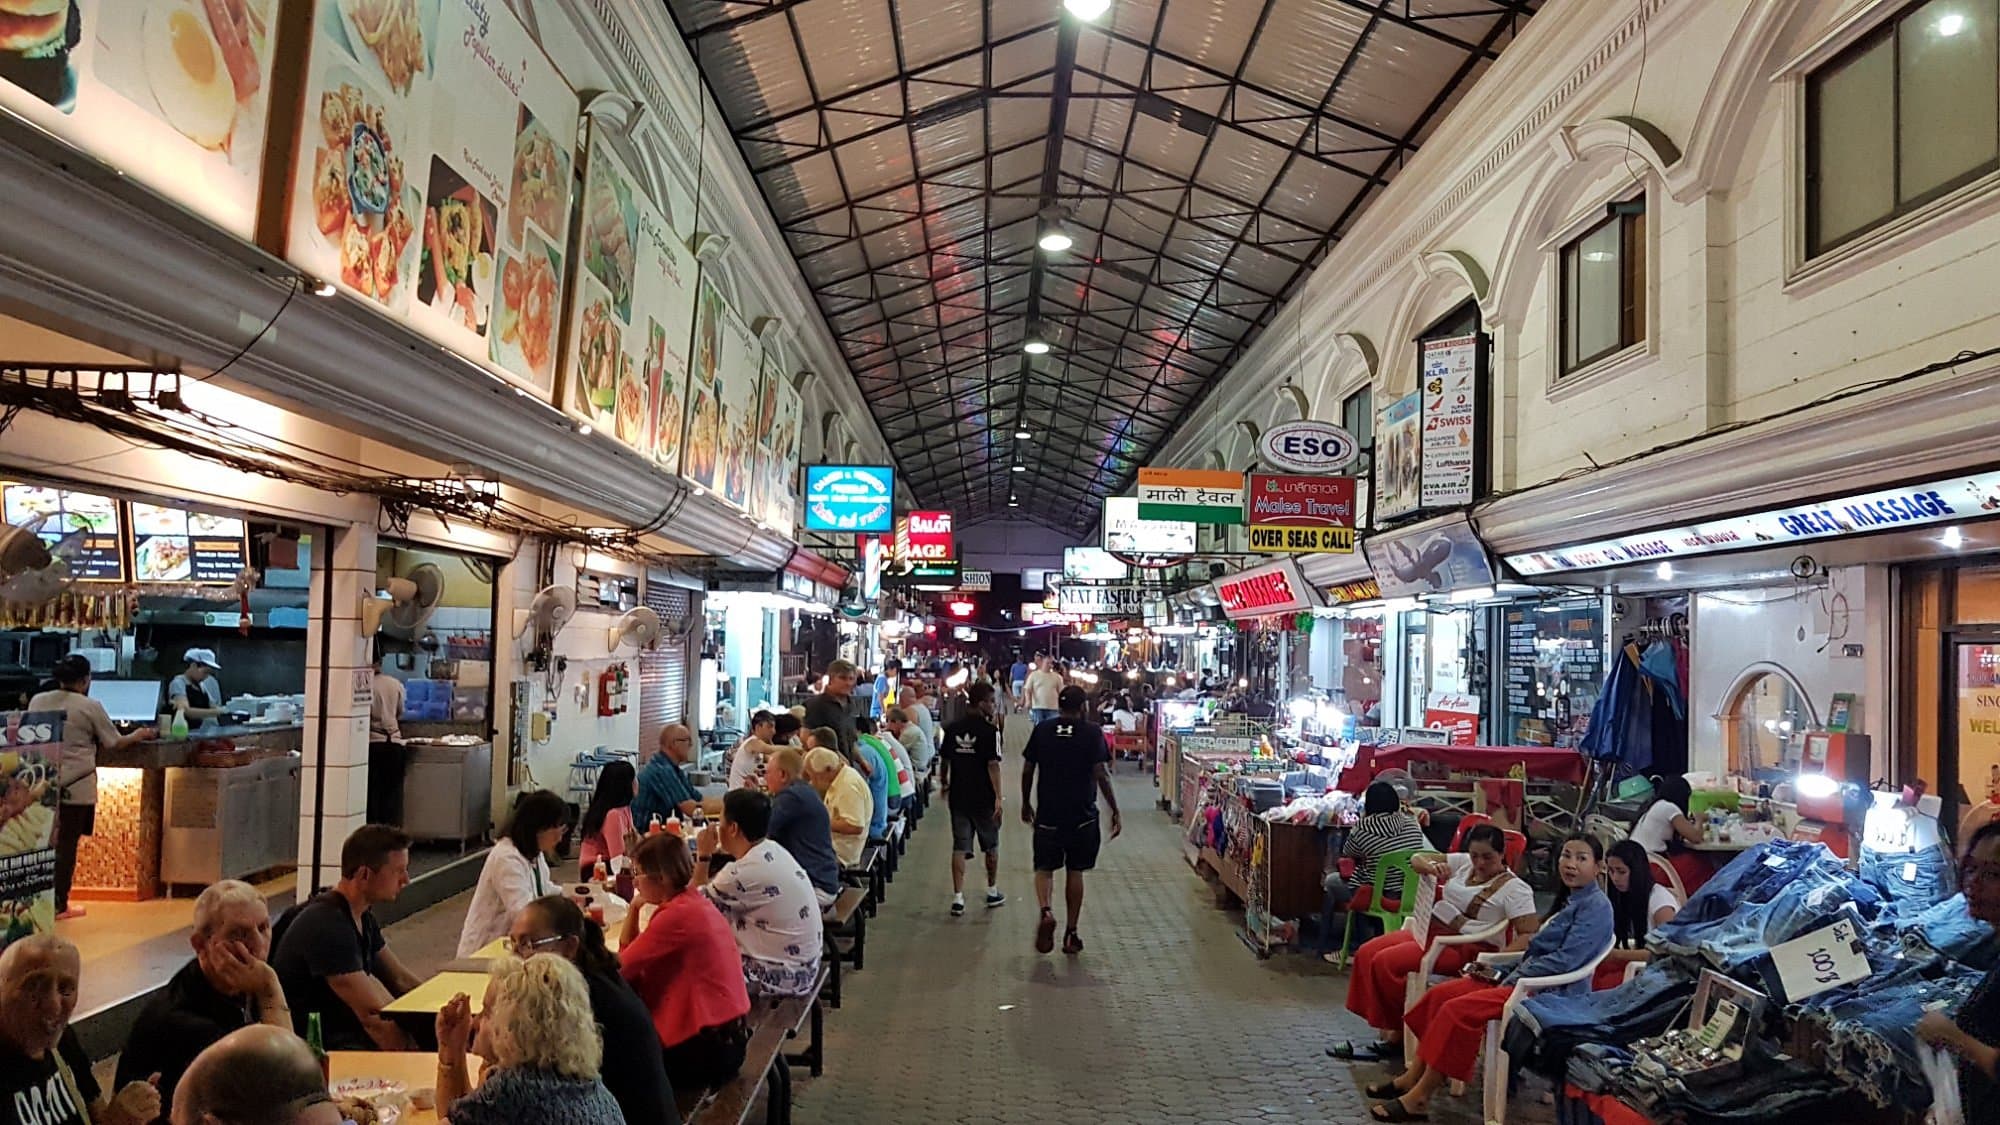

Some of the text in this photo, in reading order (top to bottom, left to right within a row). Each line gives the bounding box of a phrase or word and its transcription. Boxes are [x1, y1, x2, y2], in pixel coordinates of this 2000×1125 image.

[1426, 367, 1448, 377] KLM
[1440, 415, 1471, 428] SWISS
[1284, 436, 1341, 457] ESO
[1254, 496, 1350, 516] Malee Travel
[1778, 491, 1956, 537] GREAT MASSAGE
[1252, 529, 1351, 549] OVER SEAS CALL
[1626, 540, 1673, 559] MASSAGE
[1061, 589, 1091, 604] NEXT
